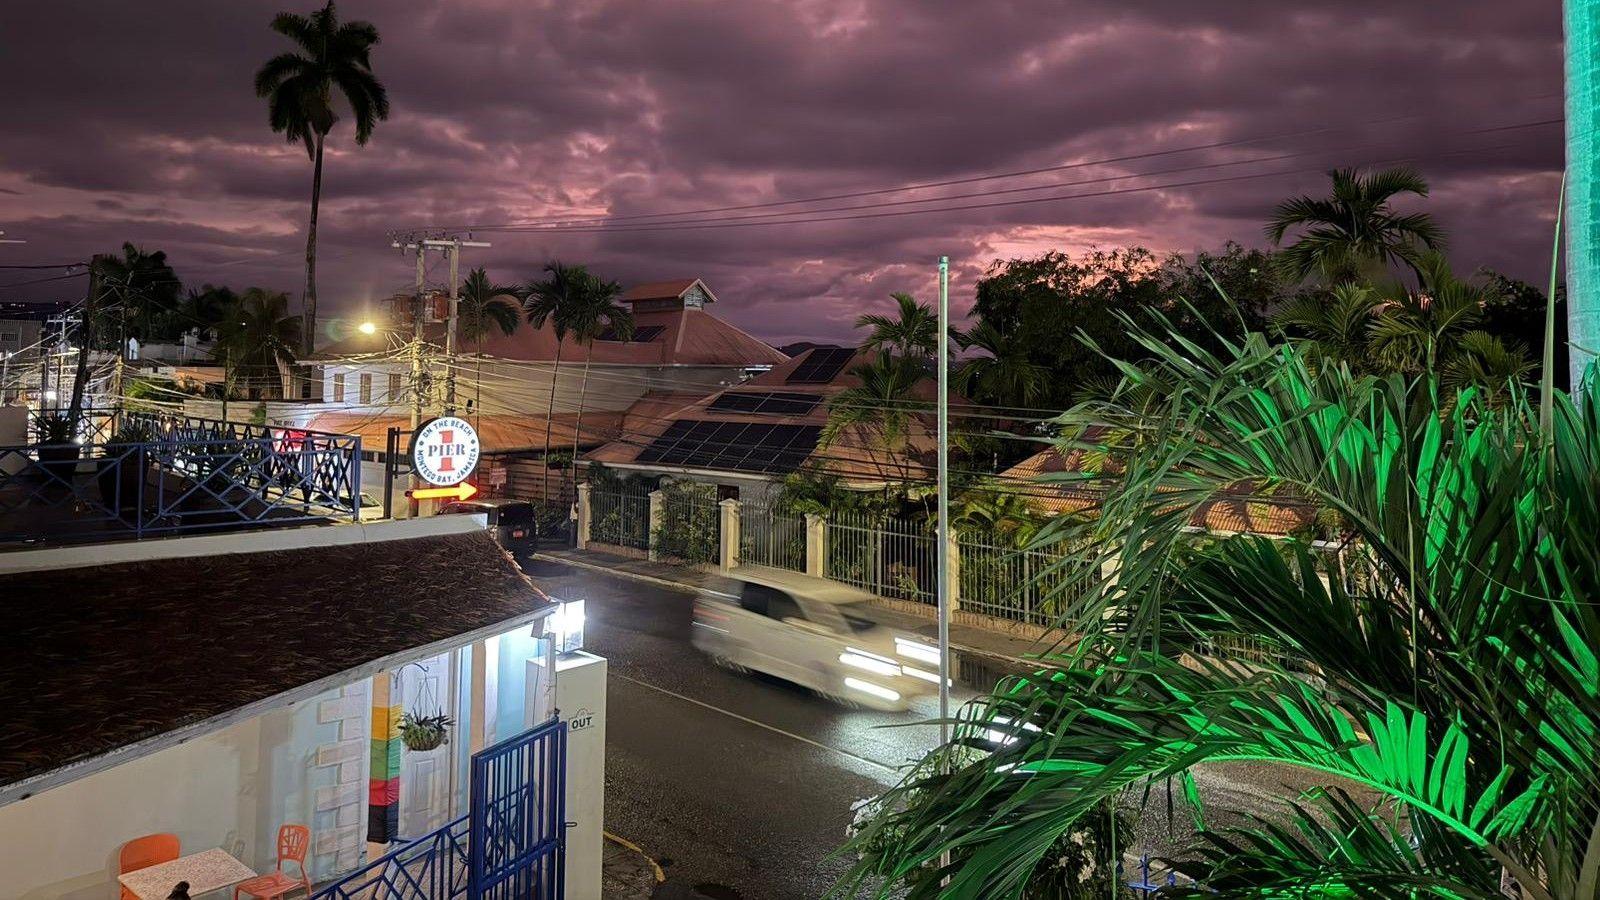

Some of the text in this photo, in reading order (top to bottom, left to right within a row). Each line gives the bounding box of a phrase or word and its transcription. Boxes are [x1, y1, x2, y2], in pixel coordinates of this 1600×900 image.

[422, 420, 472, 438] ON THE BEACH
[428, 443, 465, 457] PIER
[437, 430, 455, 472] 1
[417, 449, 436, 480] MONTEGO
[457, 447, 477, 479] JAMAICA
[572, 716, 593, 729] OUT
